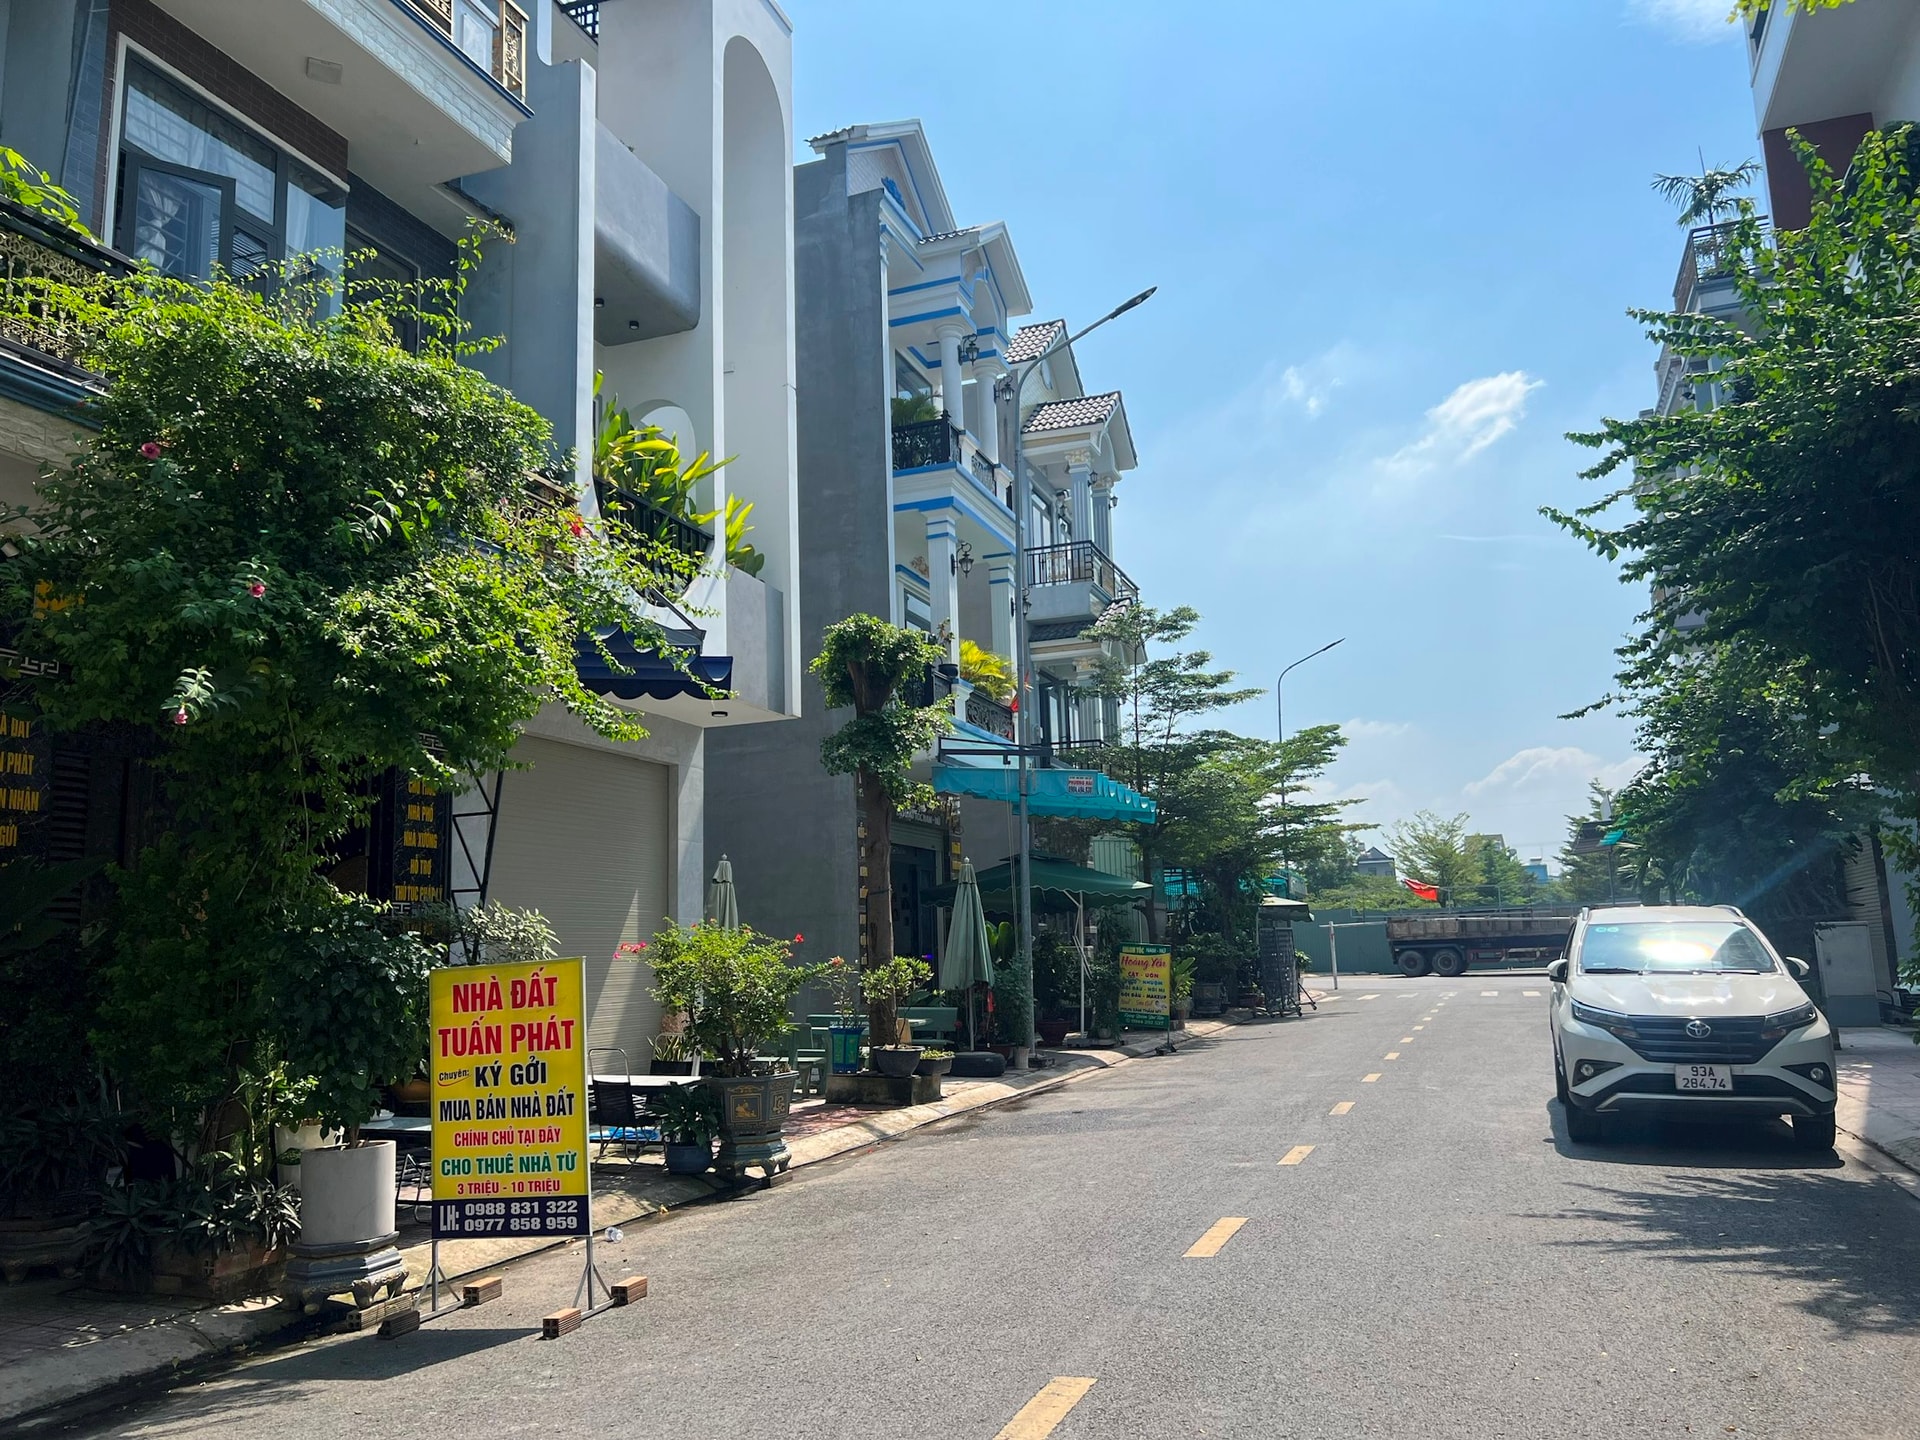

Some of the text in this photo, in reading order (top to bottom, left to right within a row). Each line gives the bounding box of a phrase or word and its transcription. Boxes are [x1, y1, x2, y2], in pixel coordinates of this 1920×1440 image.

[452, 966, 558, 1013] NHÀ ĐẤT
[438, 1014, 575, 1057] TUẤN PHÁT
[438, 1055, 547, 1087] Chuyên: KÝ GỞI
[1682, 1077, 1726, 1089] 284.74
[1690, 1065, 1715, 1077] 93A
[439, 1085, 575, 1122] MUA BÁN NHÀ ĐẤT
[454, 1125, 561, 1147] CHÍNH CHỦ TẠI ĐÂY
[441, 1150, 577, 1176] CHO THUÊ NHÀ TỪ
[457, 1183, 464, 1195] 3
[467, 1181, 500, 1196] TRIỆU
[511, 1181, 525, 1193] 10
[527, 1178, 561, 1195] TRIỆU
[439, 1199, 578, 1231] LH: 0988 831 322
[463, 1215, 578, 1232] 0977 858 959
